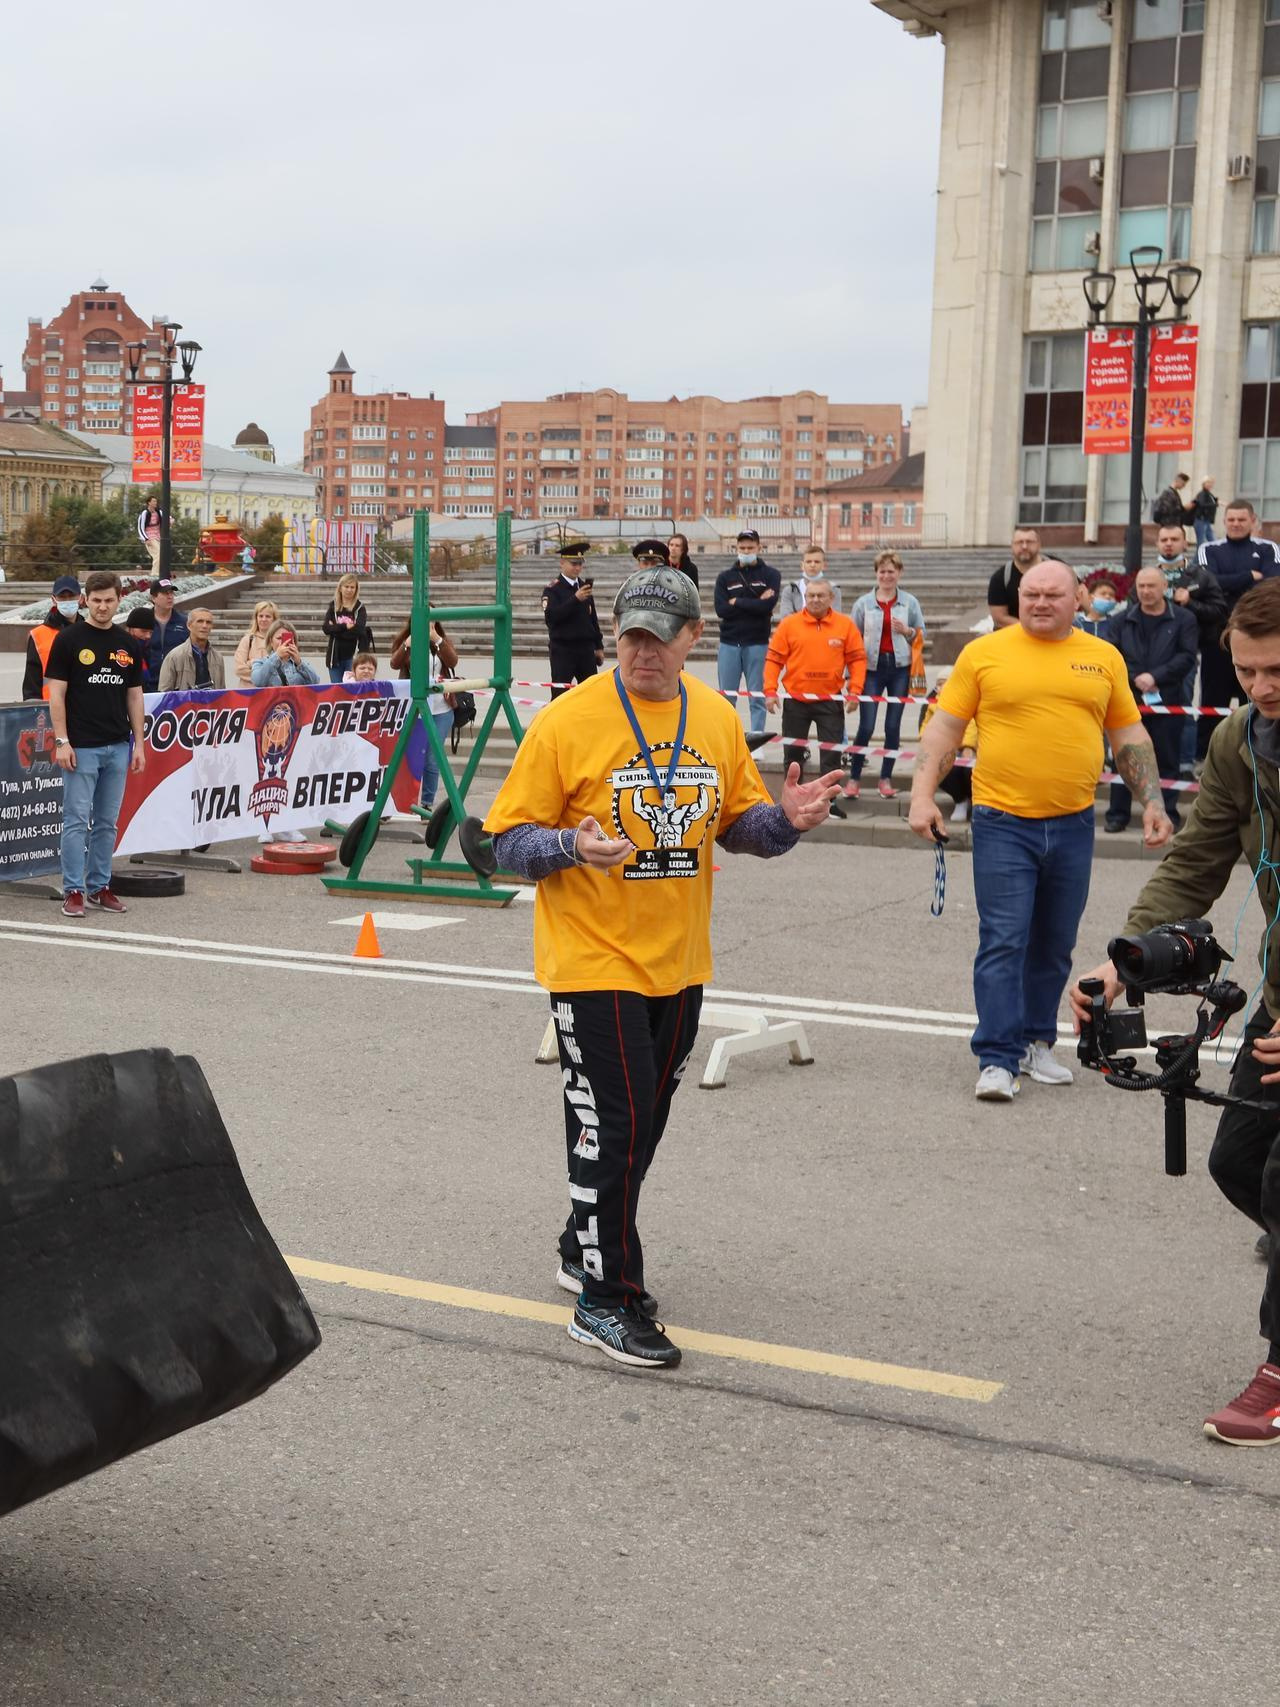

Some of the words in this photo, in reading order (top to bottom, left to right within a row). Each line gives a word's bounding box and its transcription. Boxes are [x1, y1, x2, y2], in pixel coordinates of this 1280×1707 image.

[1088, 400, 1127, 411] ТУЛА
[1150, 398, 1191, 409] ТУЛА
[134, 440, 161, 448] ТУЛА
[174, 440, 200, 448] ТУЛА
[143, 708, 248, 752] РОССИЯ
[674, 770, 714, 780] ЧЕЛОВЕК
[1, 781, 20, 796] Тула,
[22, 779, 33, 793] ул.
[35, 776, 64, 791] Тульска
[249, 787, 288, 809] НАЦИЯ
[22, 801, 57, 817] 24-68-03
[255, 801, 279, 816] МИРА
[9, 853, 29, 863] УСЛУГИ
[624, 870, 664, 879] СИЛОВОГО
